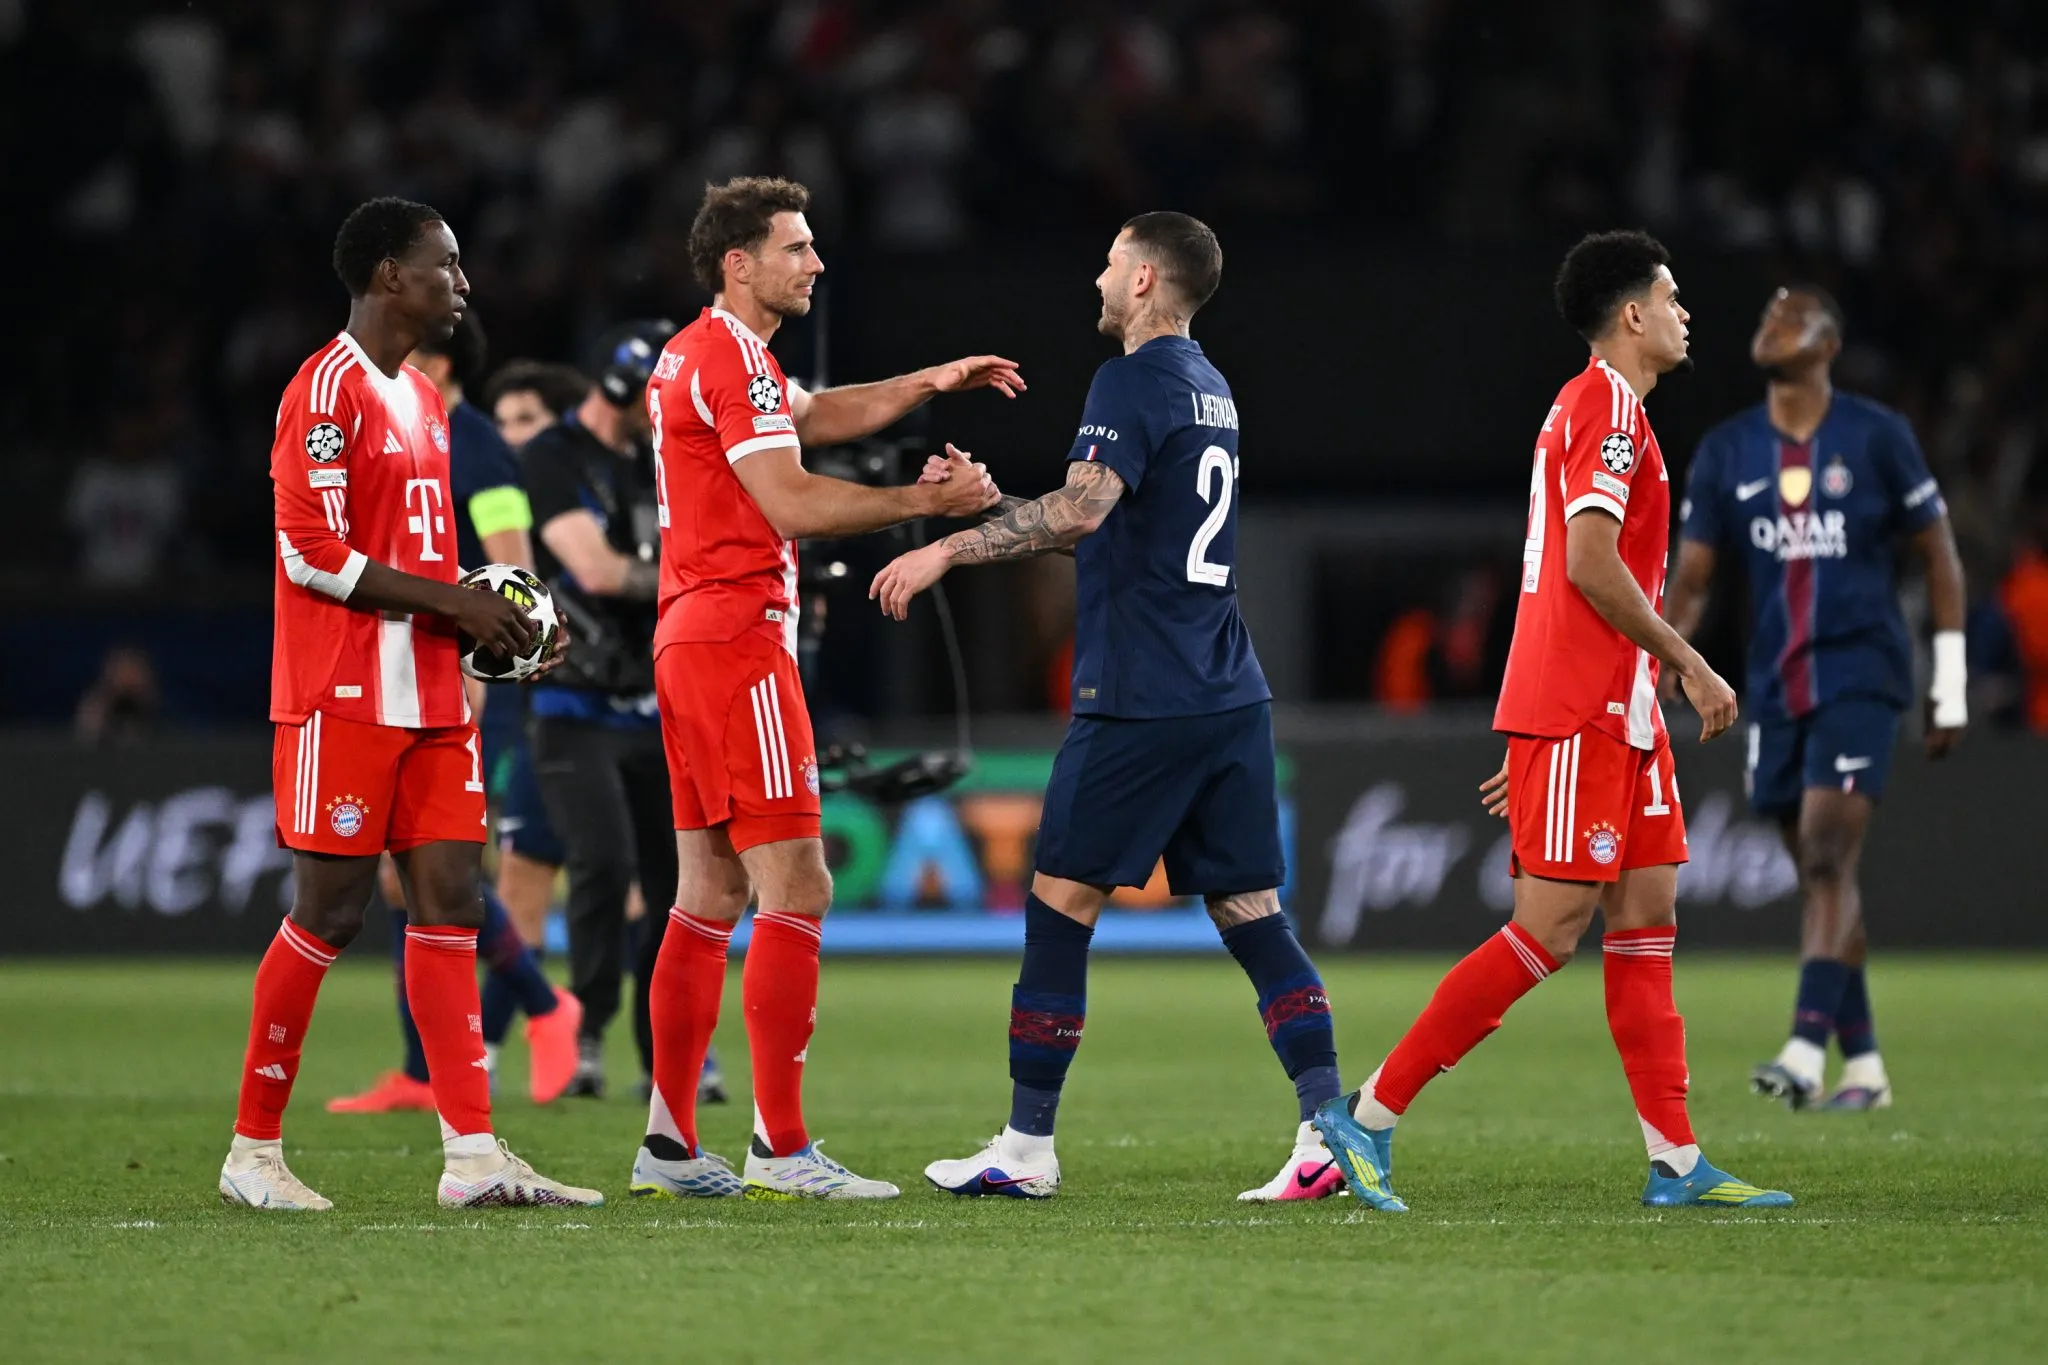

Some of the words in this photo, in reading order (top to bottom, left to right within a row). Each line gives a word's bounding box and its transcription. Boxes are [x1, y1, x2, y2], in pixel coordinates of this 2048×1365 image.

[1187, 445, 1239, 588] 2
[1749, 509, 1846, 554] QATAR
[1643, 757, 1680, 816] 1
